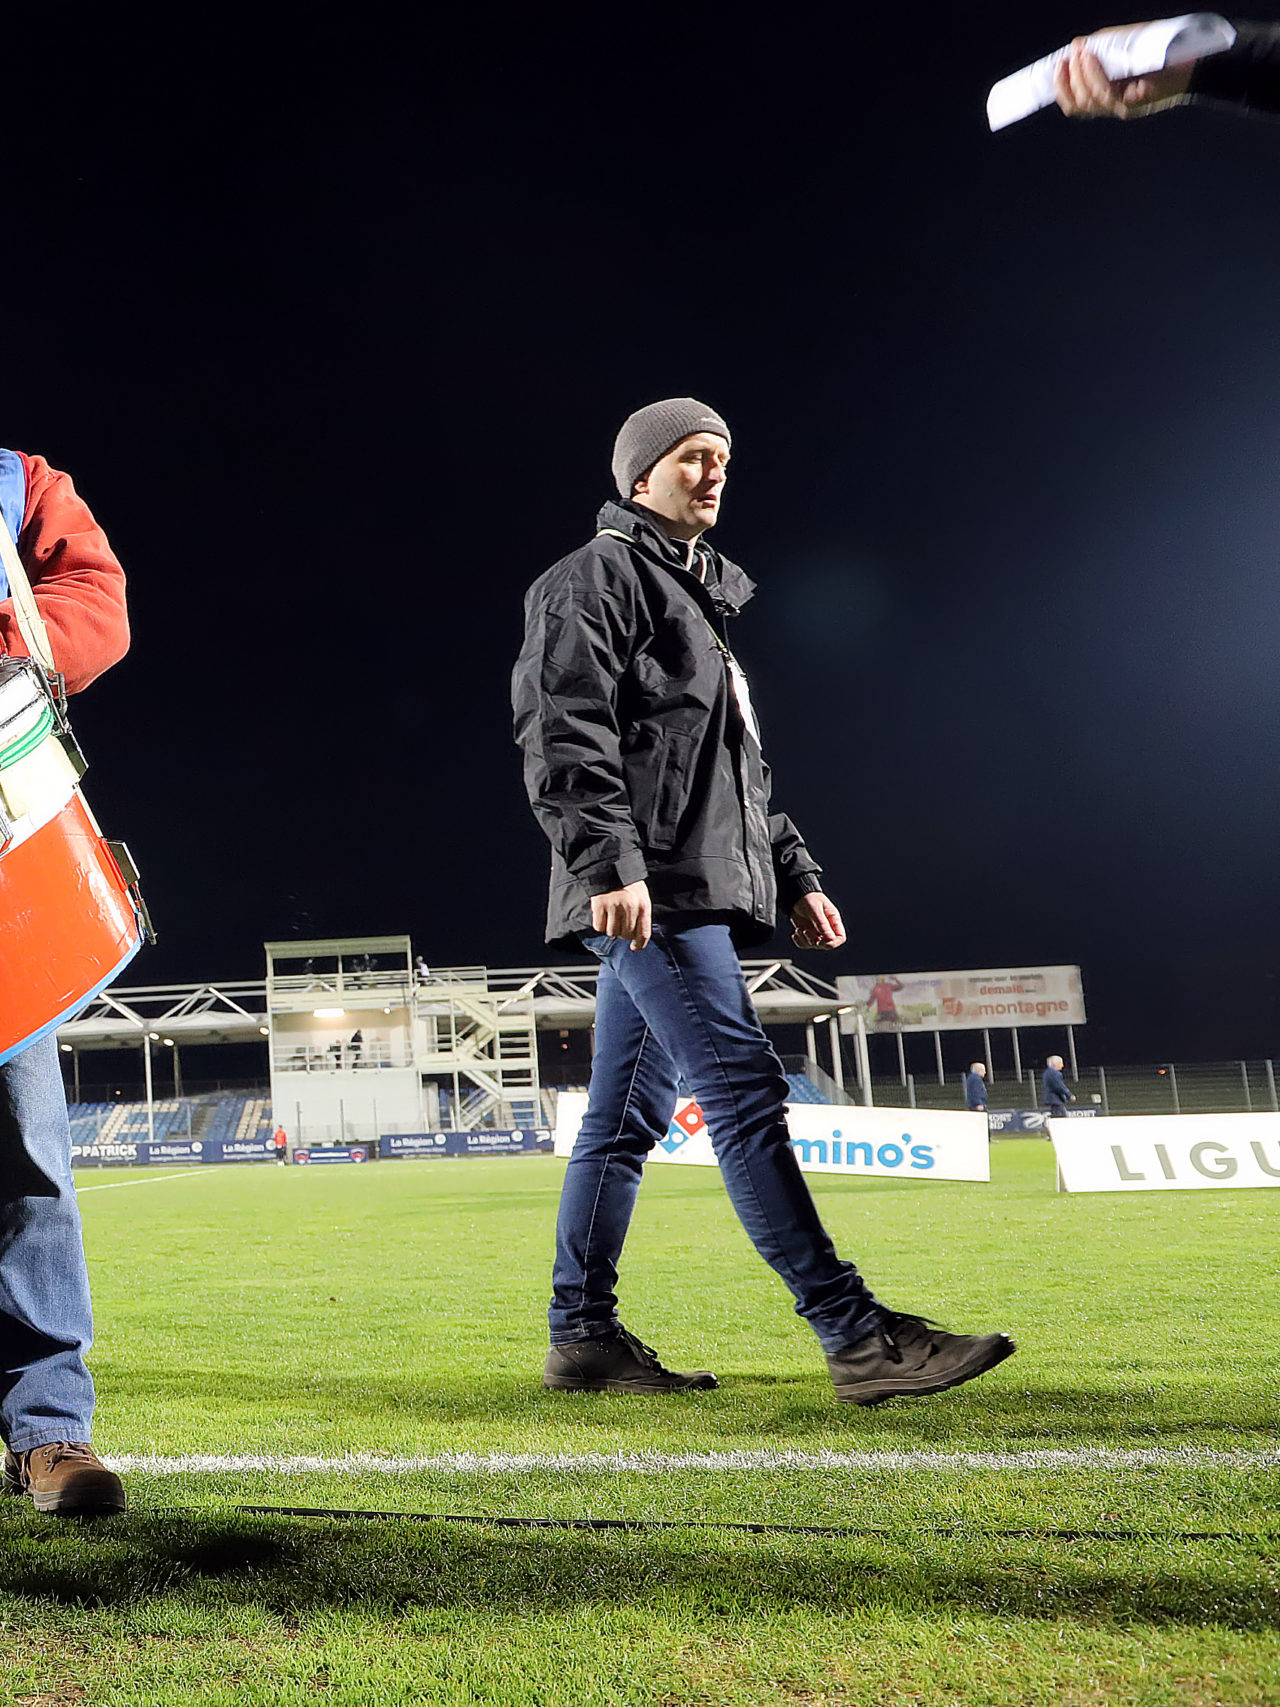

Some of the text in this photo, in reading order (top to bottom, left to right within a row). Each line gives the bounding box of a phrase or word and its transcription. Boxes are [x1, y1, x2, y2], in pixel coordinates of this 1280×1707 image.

[979, 1000, 1068, 1016] montagne
[83, 1144, 137, 1157] PATRICK
[791, 1129, 934, 1169] mino's
